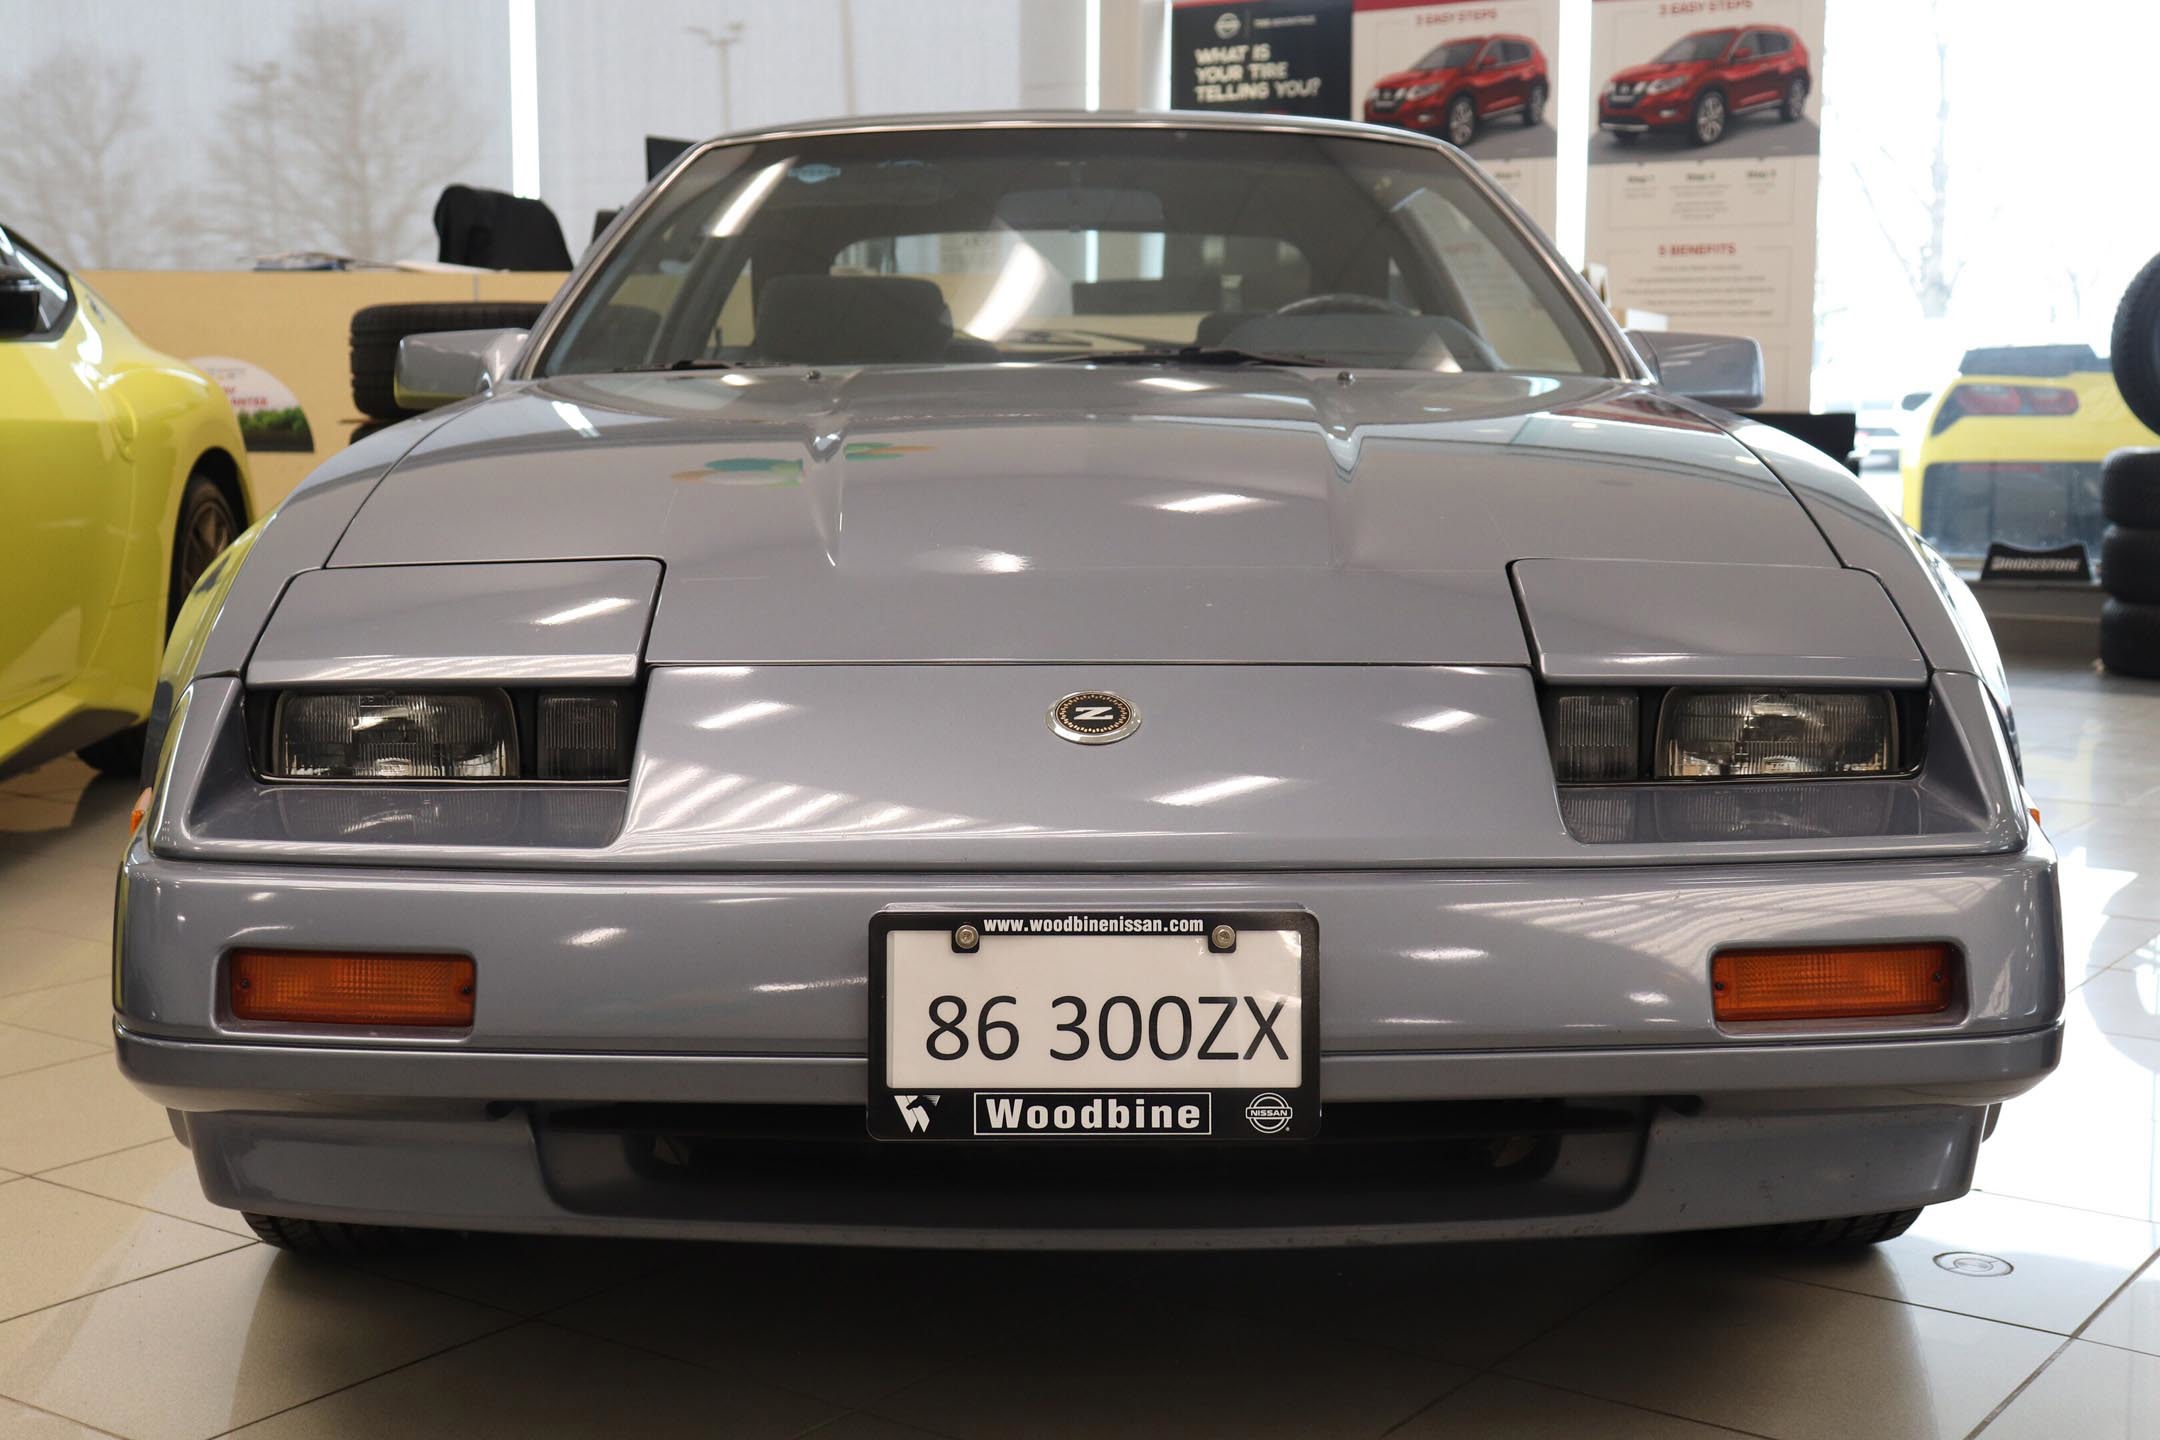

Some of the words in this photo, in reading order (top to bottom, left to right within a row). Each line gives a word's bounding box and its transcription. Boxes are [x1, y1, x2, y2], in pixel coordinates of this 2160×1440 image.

[1457, 8, 1498, 22] STEPS
[1672, 1, 1705, 14] EASY
[1194, 44, 1249, 65] WHAT
[1251, 43, 1271, 62] IS
[1194, 64, 1244, 84] YOUR
[1247, 61, 1289, 80] TIRE
[1194, 81, 1270, 103] TELLING
[1274, 77, 1322, 98] YOU?
[1670, 242, 1737, 256] BENEFITS
[1991, 556, 2081, 572] BRIDGESTONE
[1073, 706, 1114, 720] Z
[984, 916, 1204, 933] www.woodbinenissan.com
[925, 995, 1020, 1061] 86
[1049, 995, 1290, 1061] 300ZX
[985, 1098, 1201, 1130] Woodbine
[1250, 1109, 1288, 1117] NISSAN
